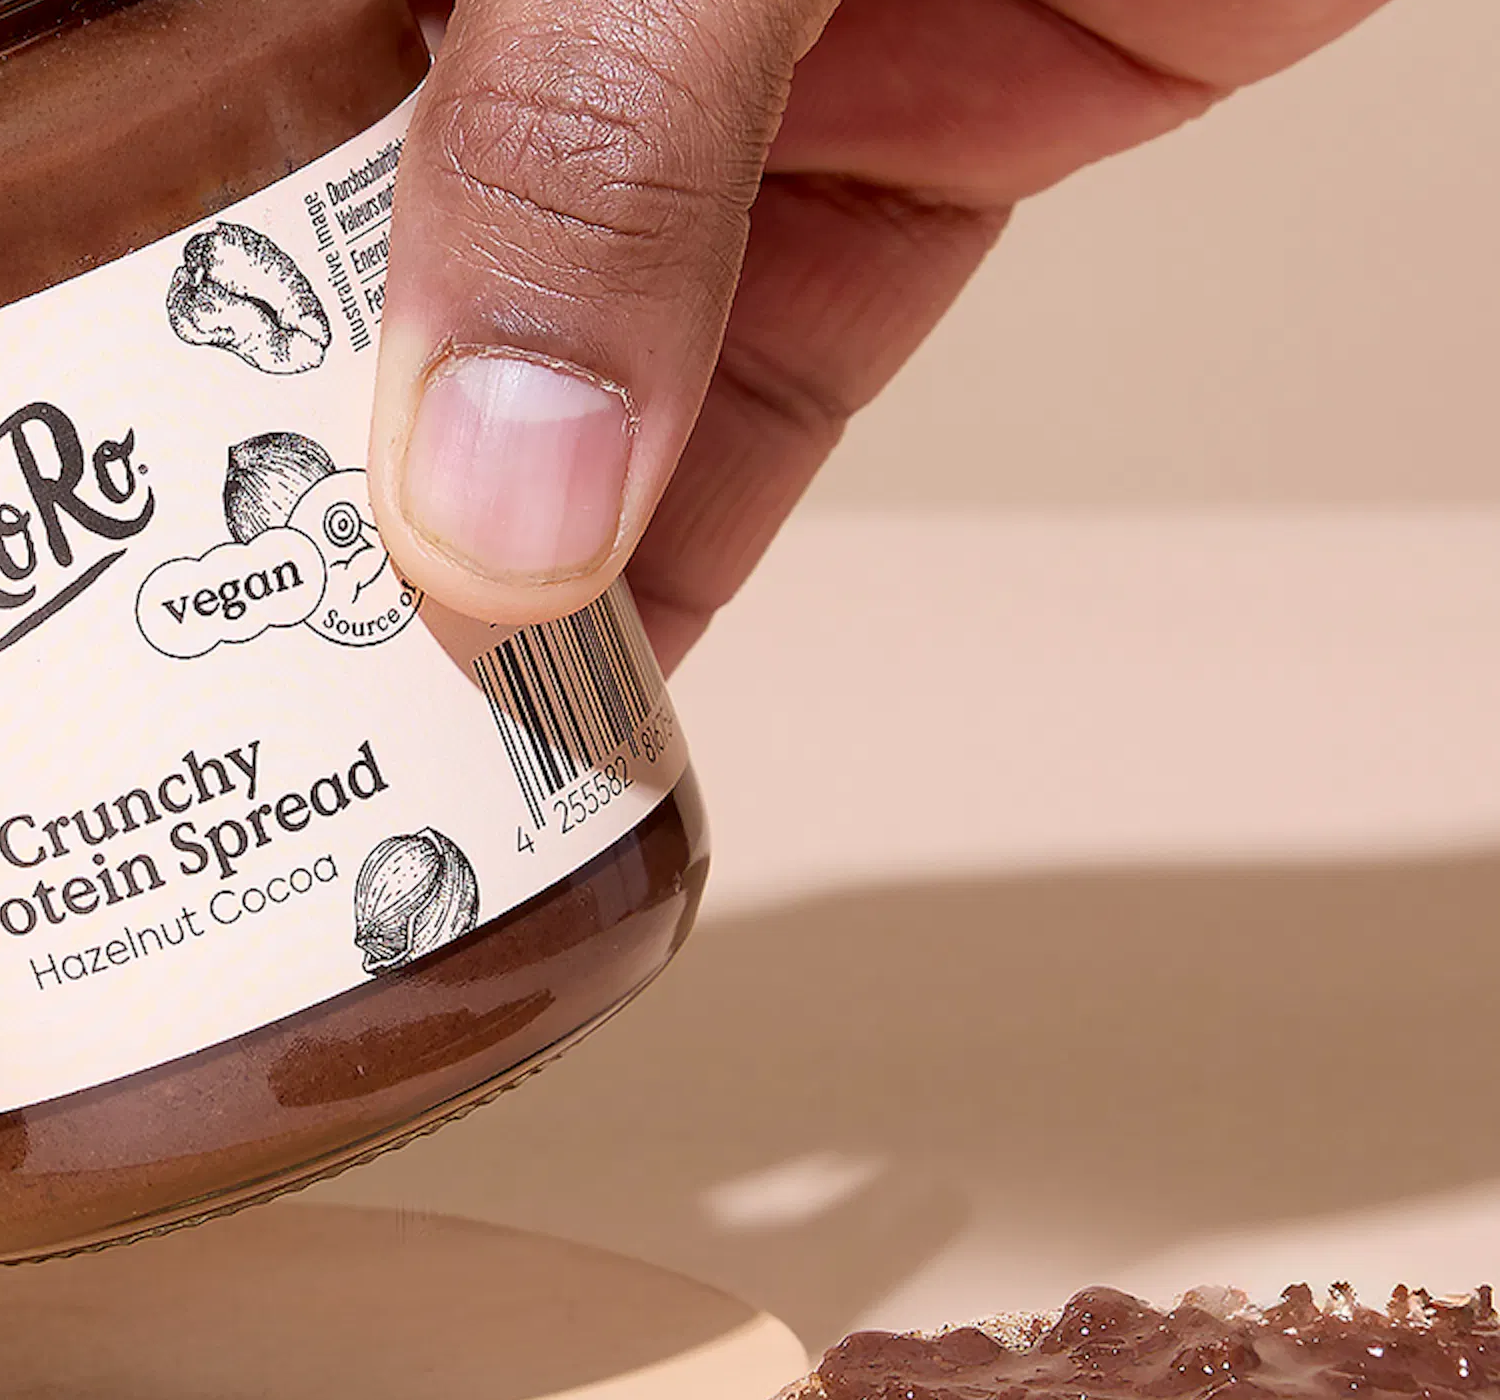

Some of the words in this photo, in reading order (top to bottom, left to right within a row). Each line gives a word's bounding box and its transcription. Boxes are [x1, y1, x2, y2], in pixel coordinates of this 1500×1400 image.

[304, 191, 335, 252] Image
[325, 250, 371, 352] Illustrative
[162, 560, 304, 620] vegan
[323, 609, 400, 636] Source
[169, 740, 389, 879] Spread
[516, 825, 536, 855] 4
[553, 754, 634, 834] 255582
[28, 906, 205, 991] Hazelnut
[209, 853, 340, 925] Cocoa
